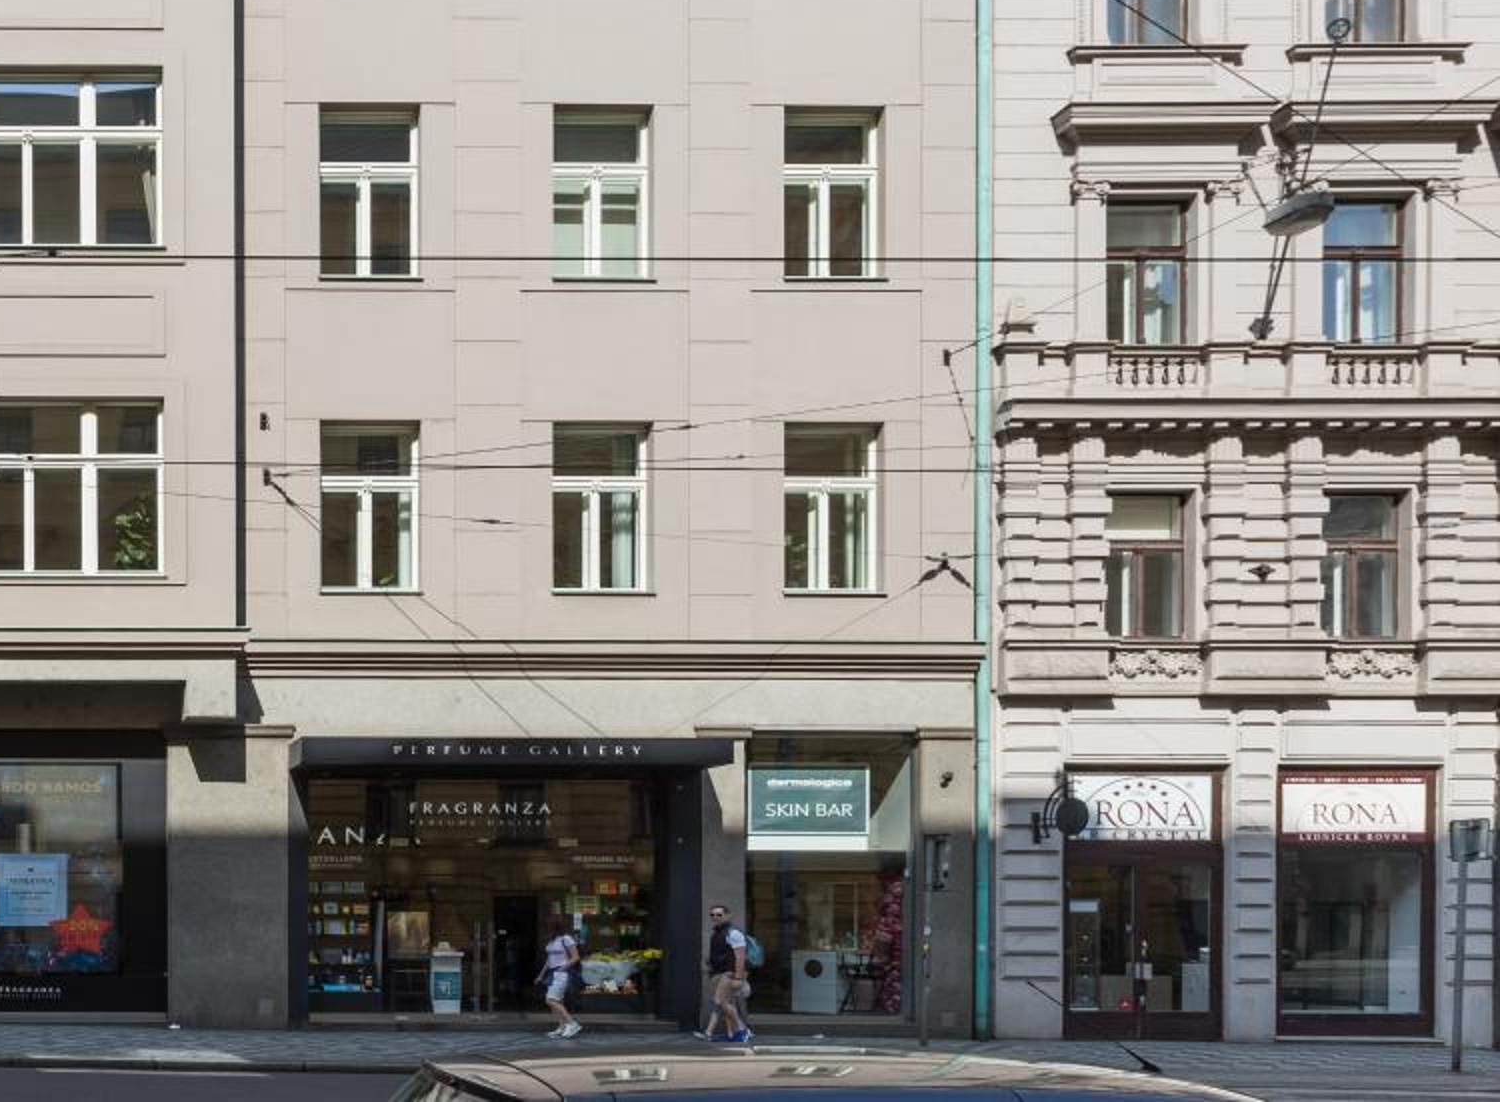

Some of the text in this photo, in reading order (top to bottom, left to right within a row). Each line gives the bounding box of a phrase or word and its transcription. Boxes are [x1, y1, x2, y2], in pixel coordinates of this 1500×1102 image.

[393, 745, 642, 756] PERFUME GALLERY
[409, 801, 551, 815] FRAGRANZA
[764, 802, 853, 818] SKIN BAR
[1094, 799, 1197, 828] RONA
[1312, 802, 1397, 826] RONA
